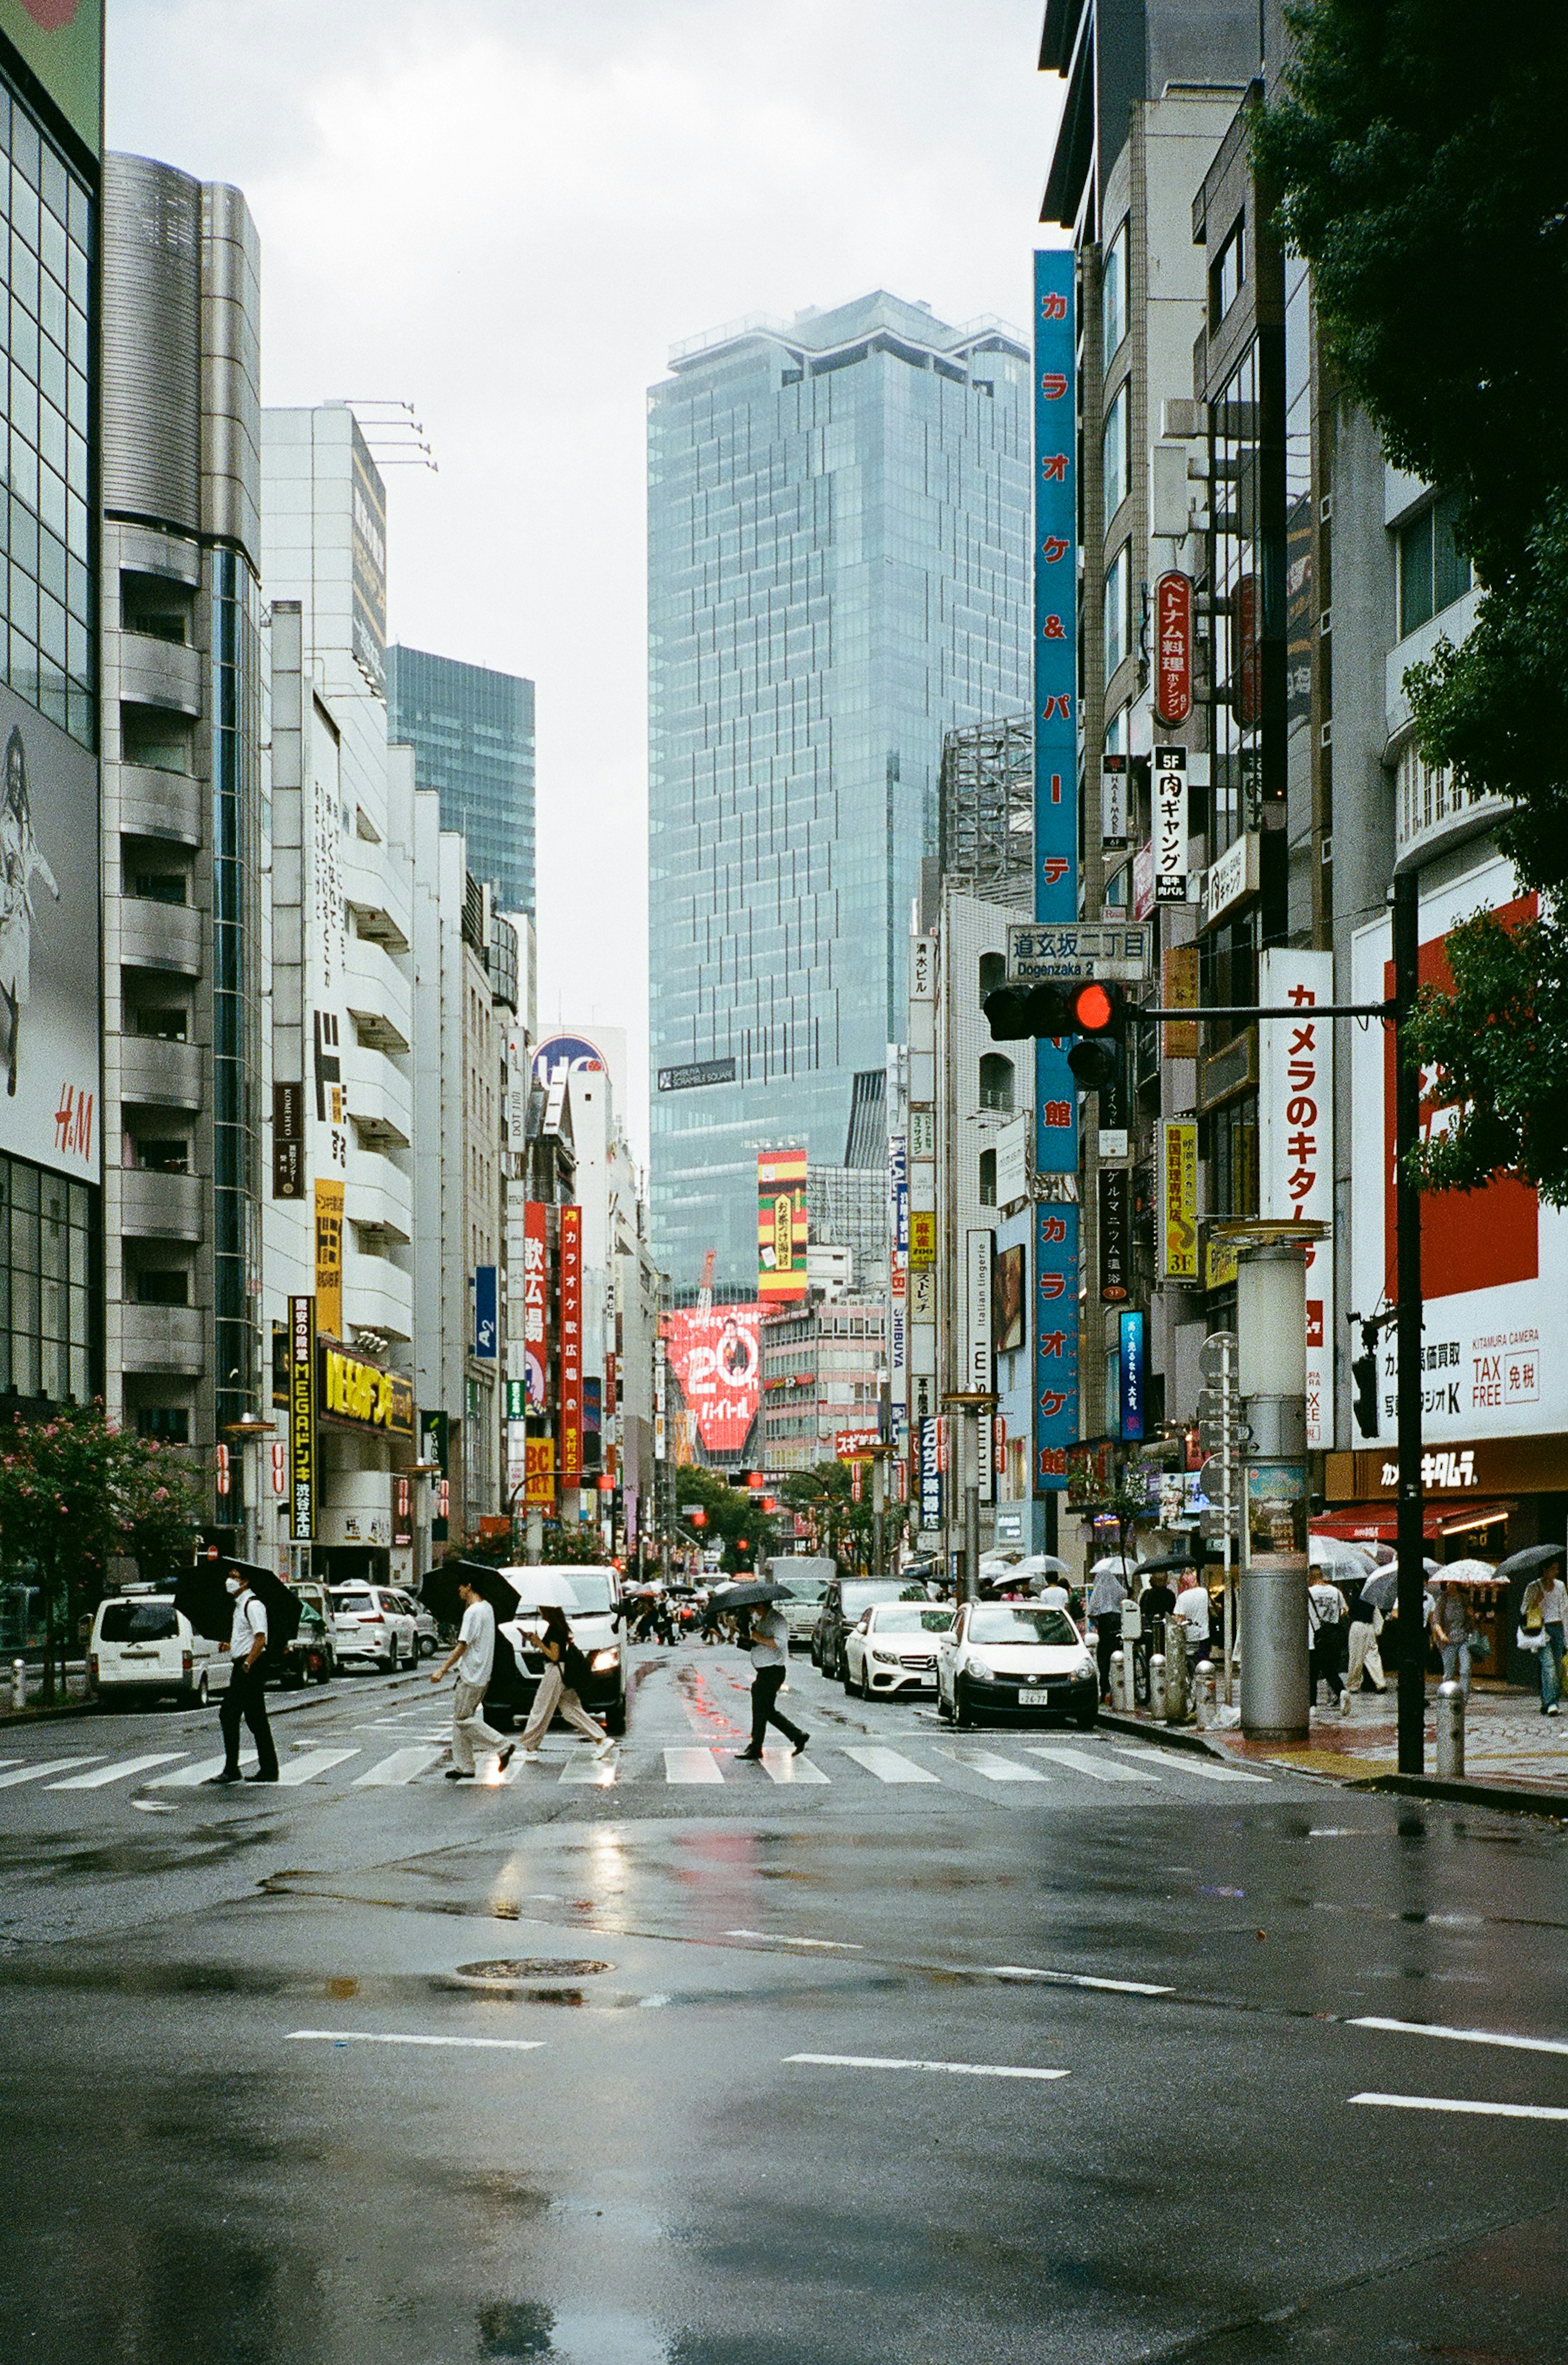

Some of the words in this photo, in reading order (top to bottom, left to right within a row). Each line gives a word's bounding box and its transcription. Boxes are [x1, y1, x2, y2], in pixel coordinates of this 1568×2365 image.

[1163, 580, 1184, 671] ベトナム料理
[1163, 755, 1179, 768] 5F
[1110, 806, 1119, 835] MAKE
[1159, 772, 1182, 872] 肉ギャング
[1158, 887, 1184, 896] 肉バル
[1162, 876, 1180, 885] 和牛
[1211, 866, 1220, 911] 肉
[1013, 933, 1143, 958] 道玄坂二丁目
[1018, 962, 1081, 978] Dogenzaka
[1086, 962, 1094, 975] 2
[673, 1066, 700, 1079] SHIBUYA
[673, 1075, 706, 1087] SCRAMBLE
[707, 1069, 733, 1081] SQUARE
[54, 1082, 93, 1164] H&M
[512, 1114, 521, 1137] DOT
[1043, 1100, 1071, 1128] 館
[1169, 1129, 1182, 1221] 韓国料理専門店
[916, 1223, 930, 1247] 麻雀
[1107, 1171, 1121, 1285] ゲルマニウム温浴
[977, 1244, 987, 1287] lingerie
[1171, 1254, 1193, 1272] 3F
[525, 1237, 544, 1343] 歌広場
[916, 1274, 930, 1313] ストレッチ
[1109, 1289, 1120, 1298] 3F
[566, 1231, 577, 1381] カラオケ歌広場
[977, 1290, 985, 1326] Italian
[479, 1319, 495, 1347] A2
[893, 1308, 903, 1367] SHIBUYA
[1040, 1216, 1067, 1474] カラオケ館
[1472, 1334, 1507, 1350] KITAMURA
[1509, 1328, 1539, 1345] CAMERA
[1473, 1355, 1501, 1383] TAX
[1509, 1363, 1535, 1390] 免税
[702, 1396, 750, 1421] バイトル
[1472, 1383, 1501, 1407] FREE
[294, 1363, 310, 1481] MEGAドンキ
[1421, 1450, 1475, 1489] キタムラ
[296, 1483, 310, 1538] 渋谷本店
